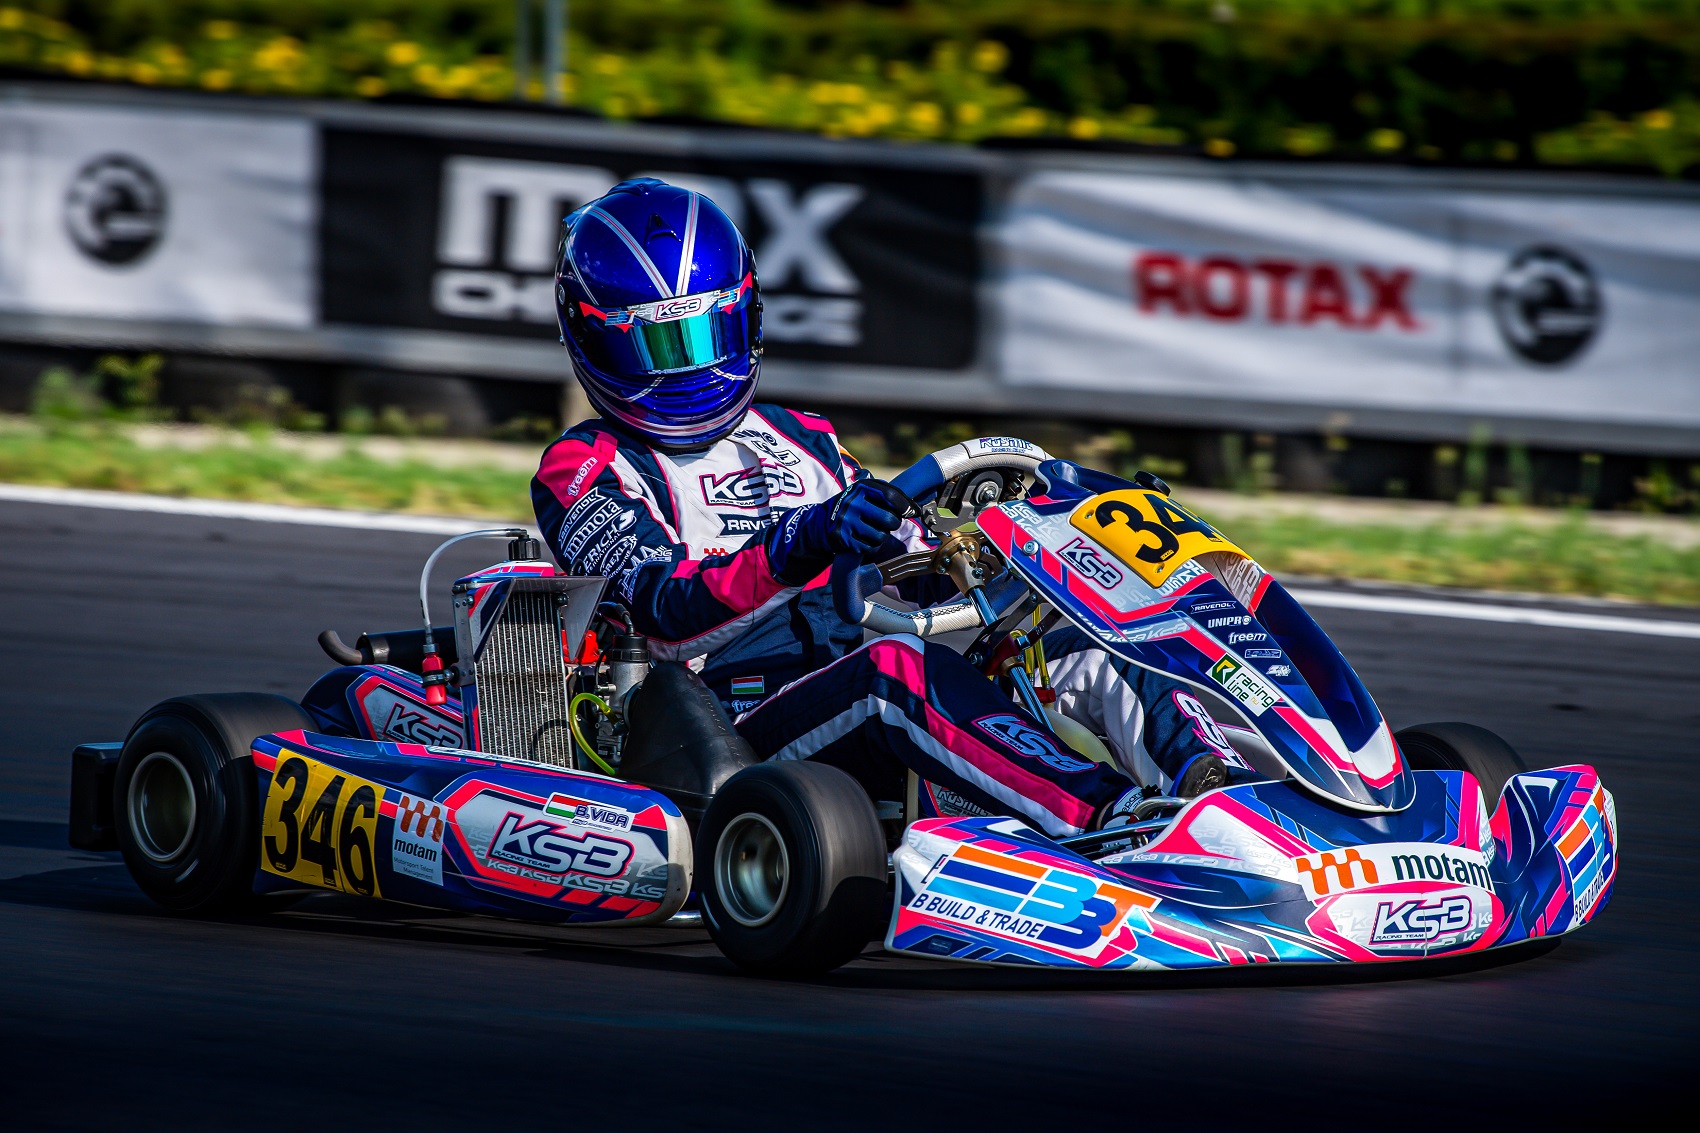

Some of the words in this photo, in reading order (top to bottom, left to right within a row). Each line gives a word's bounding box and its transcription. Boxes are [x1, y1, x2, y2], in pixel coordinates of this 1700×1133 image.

[1133, 250, 1420, 332] ROTAX
[1095, 494, 1236, 563] 34
[1194, 602, 1232, 611] RAVENOL
[1208, 615, 1251, 628] UNIPRO
[1228, 632, 1267, 645] freem
[1226, 680, 1250, 702] line
[1236, 672, 1275, 708] racing
[264, 757, 376, 896] 346
[394, 838, 438, 862] motam
[493, 849, 525, 863] RACING
[526, 859, 551, 869] TEAM
[1391, 853, 1493, 890] motam
[925, 896, 976, 921] BUILD
[976, 909, 990, 925] &
[989, 912, 1044, 938] TRADE
